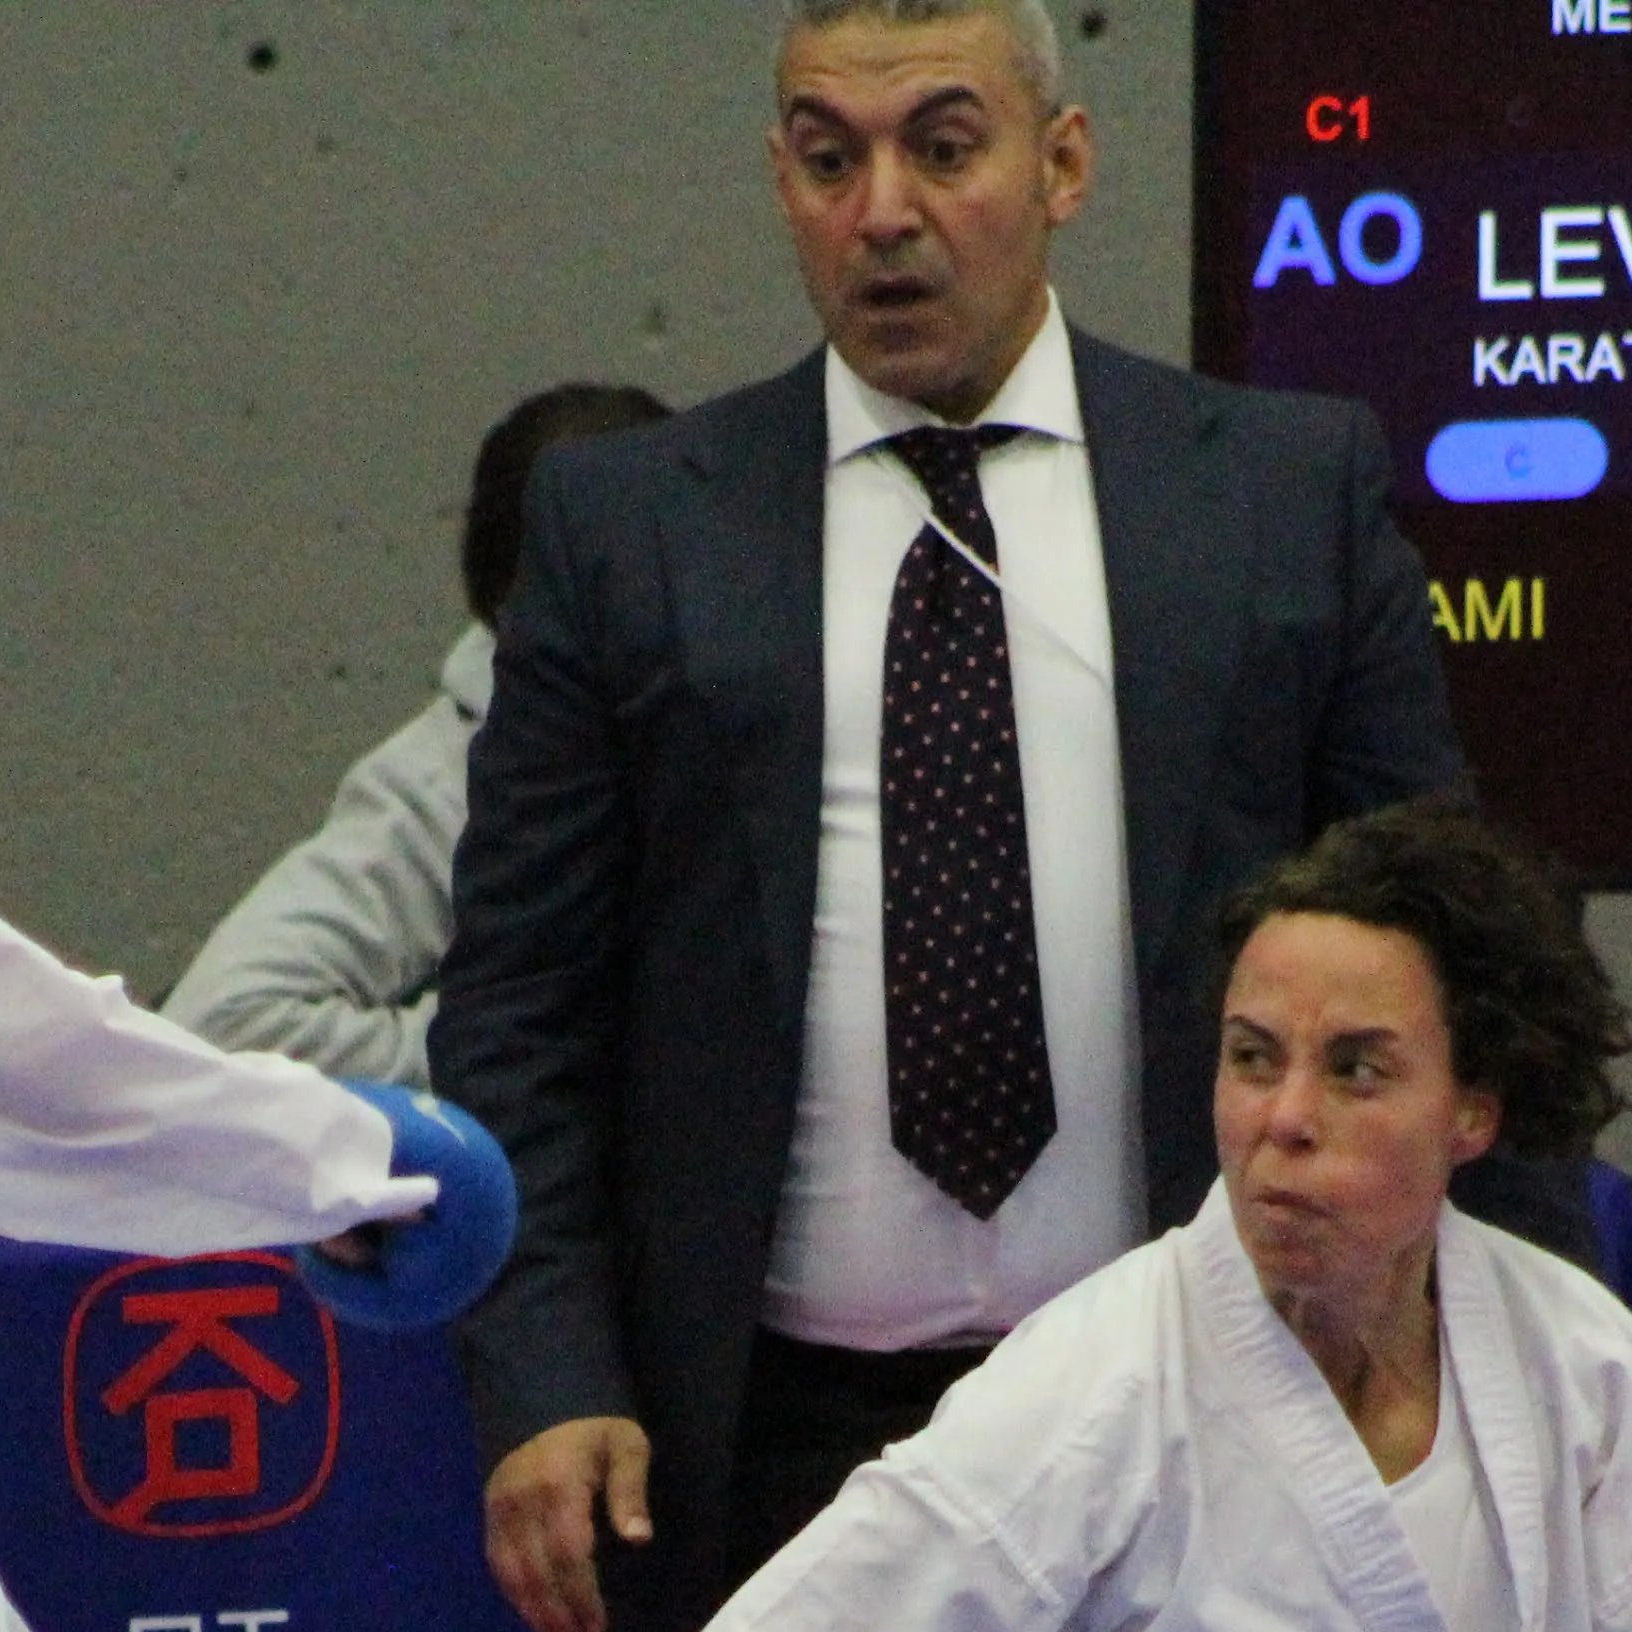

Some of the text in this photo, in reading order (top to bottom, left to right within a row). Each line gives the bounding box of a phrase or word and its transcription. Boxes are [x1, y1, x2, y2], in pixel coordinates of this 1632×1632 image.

[1305, 95, 1369, 142] C1
[1252, 192, 1423, 289] AO
[1428, 576, 1545, 642] AMI
